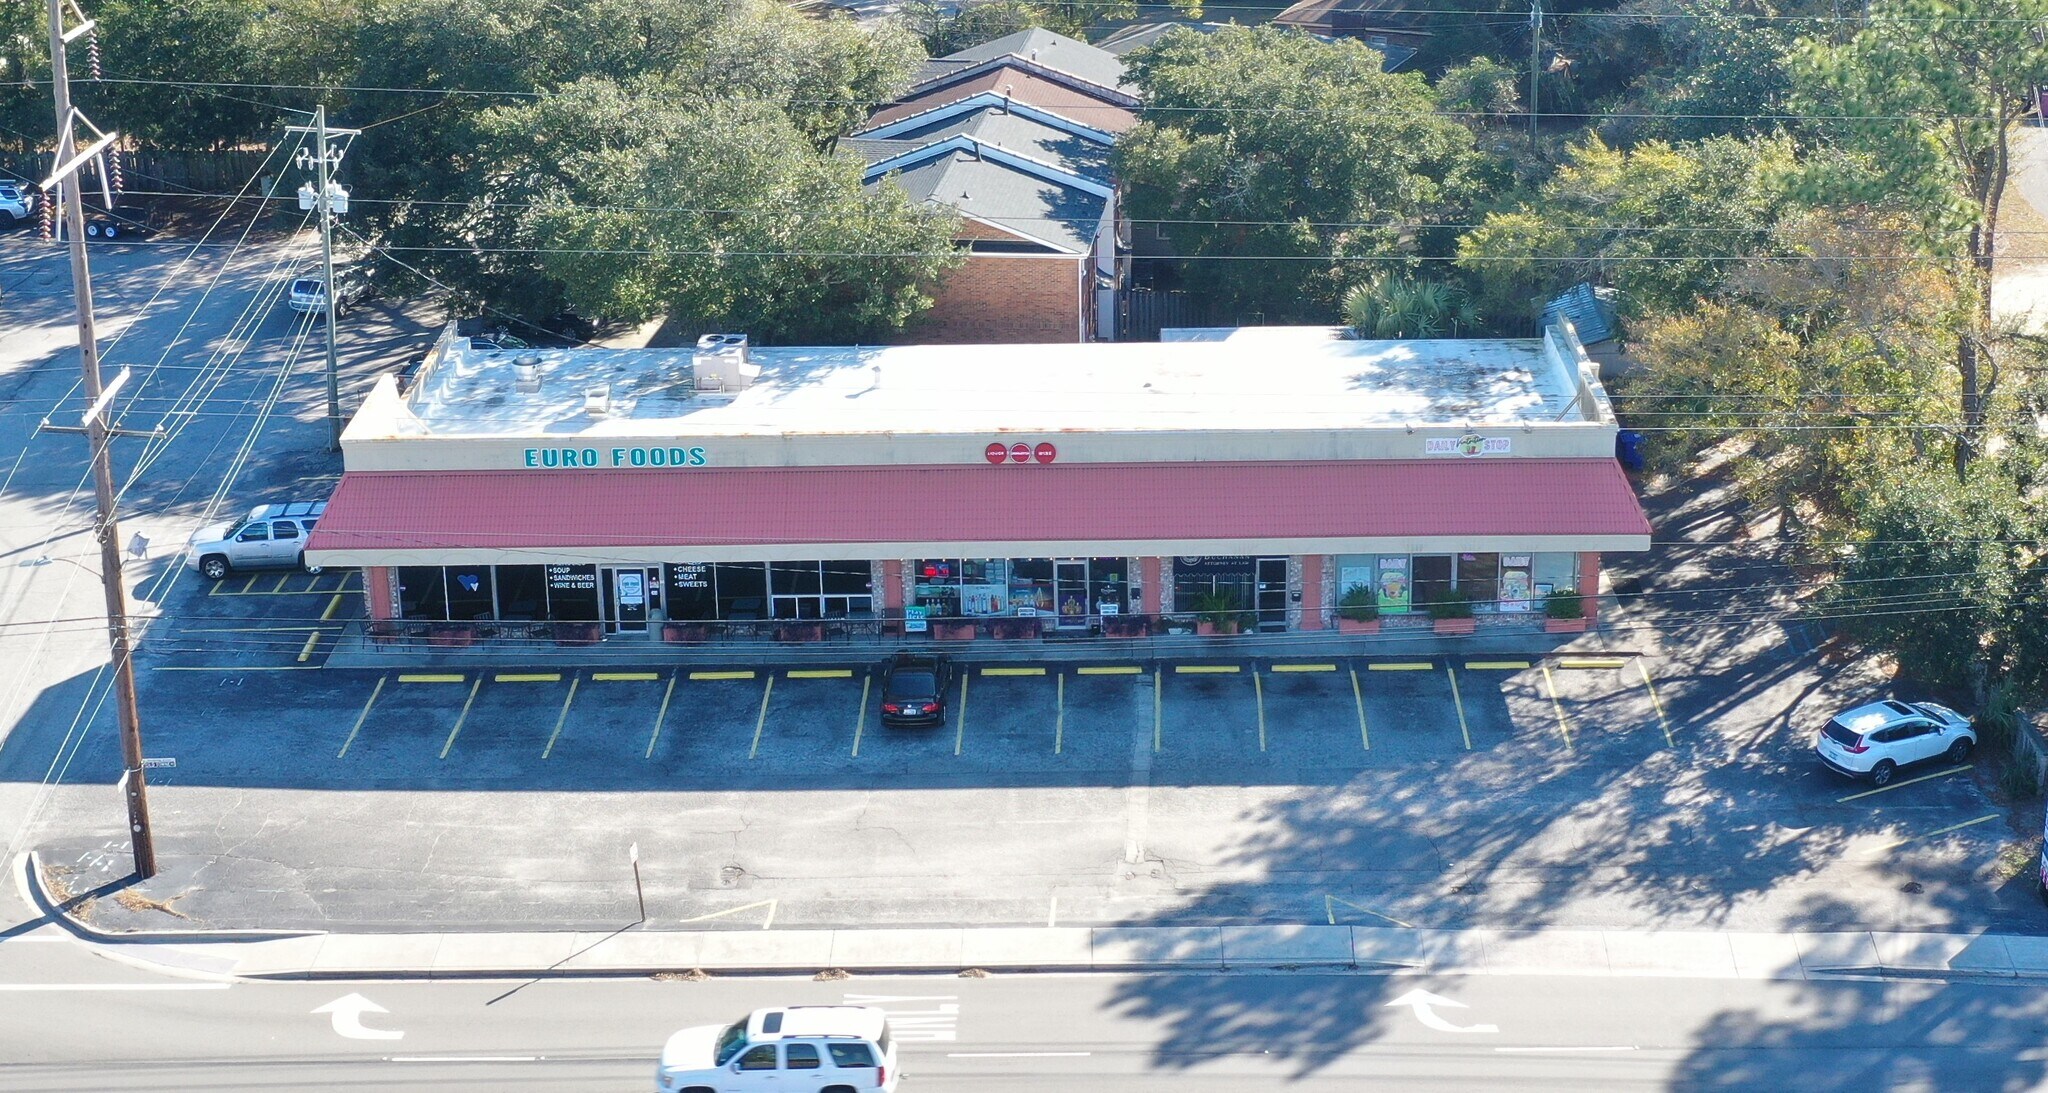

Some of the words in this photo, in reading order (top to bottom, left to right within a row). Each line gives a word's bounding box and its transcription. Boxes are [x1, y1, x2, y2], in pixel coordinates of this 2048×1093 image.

[1426, 440, 1456, 451] DAILY
[1484, 439, 1510, 450] STOP
[523, 448, 600, 468] EURO
[611, 447, 706, 468] FOODS
